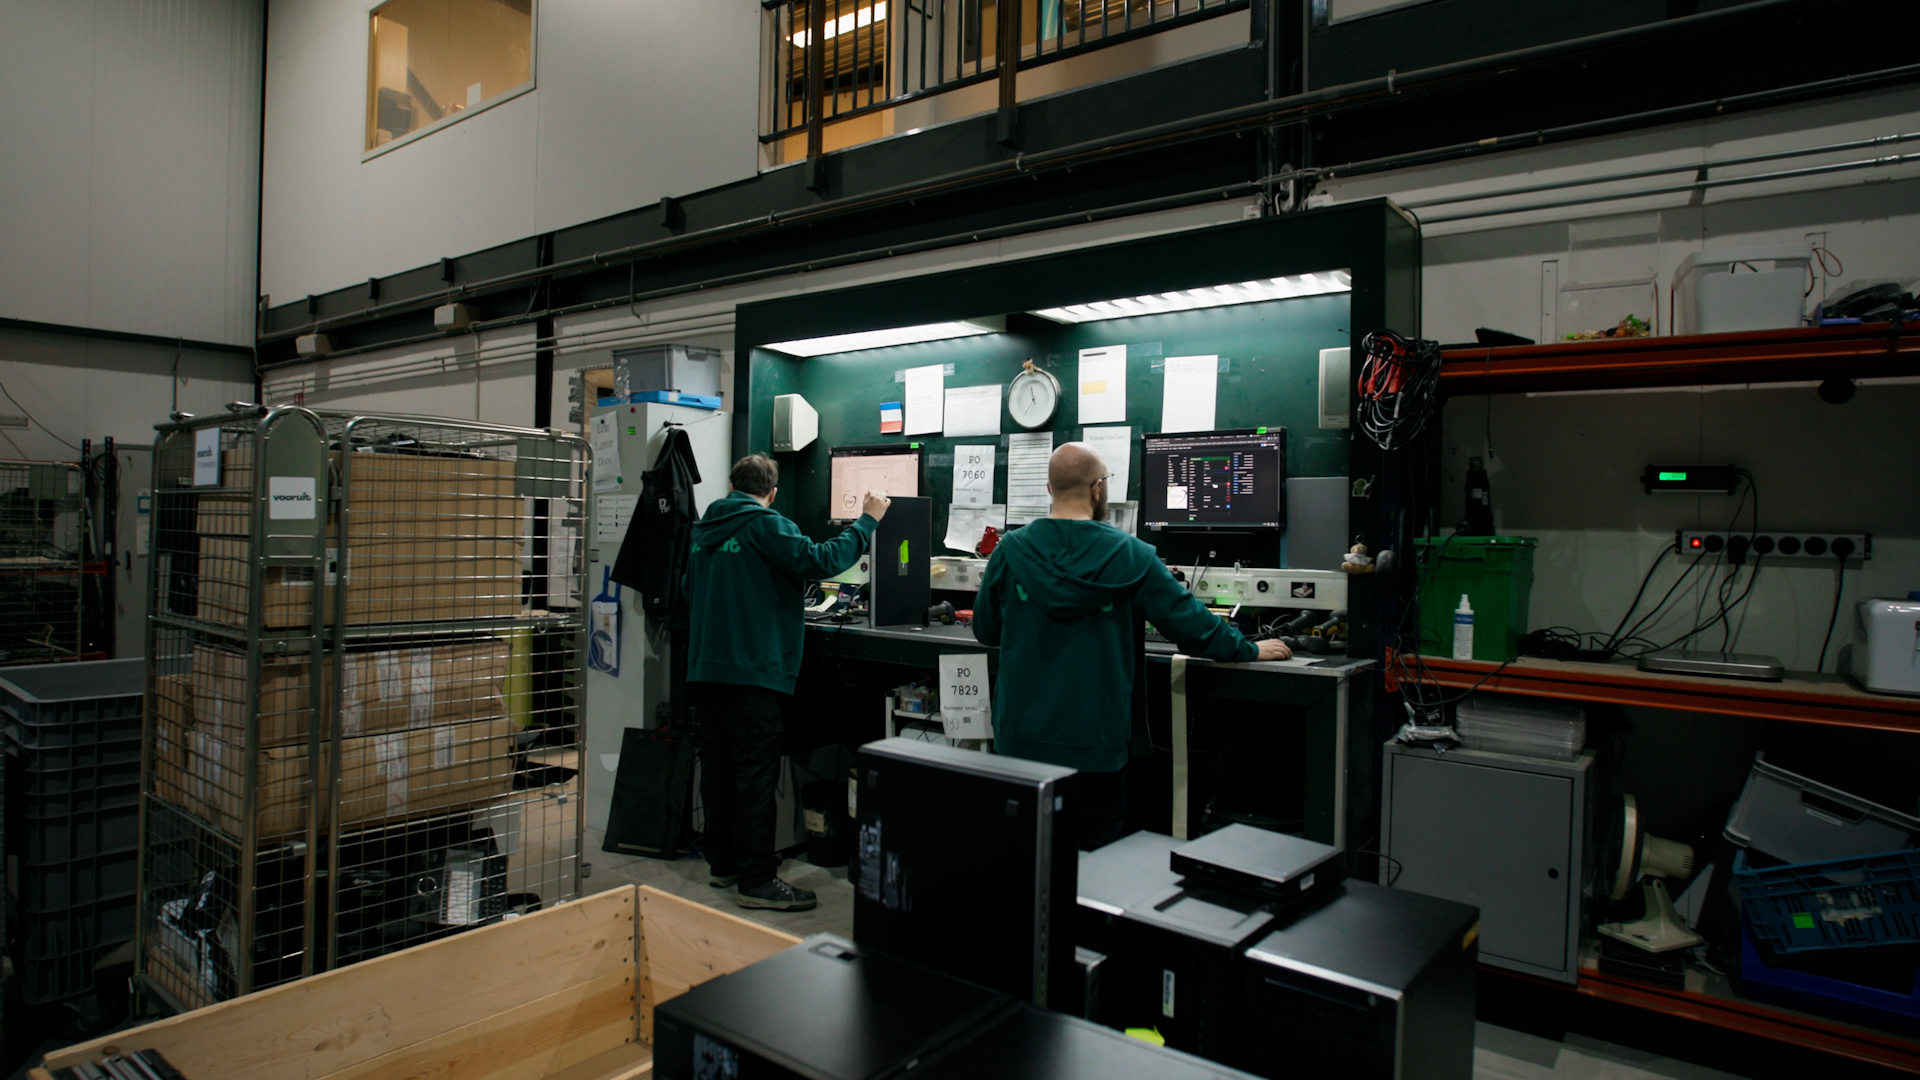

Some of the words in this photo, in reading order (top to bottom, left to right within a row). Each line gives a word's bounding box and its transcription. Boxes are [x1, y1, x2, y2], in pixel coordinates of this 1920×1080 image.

[968, 455, 981, 464] PO
[962, 470, 986, 480] 7060
[273, 492, 312, 502] vooruit
[957, 667, 971, 678] PO
[951, 685, 978, 696] 7829
